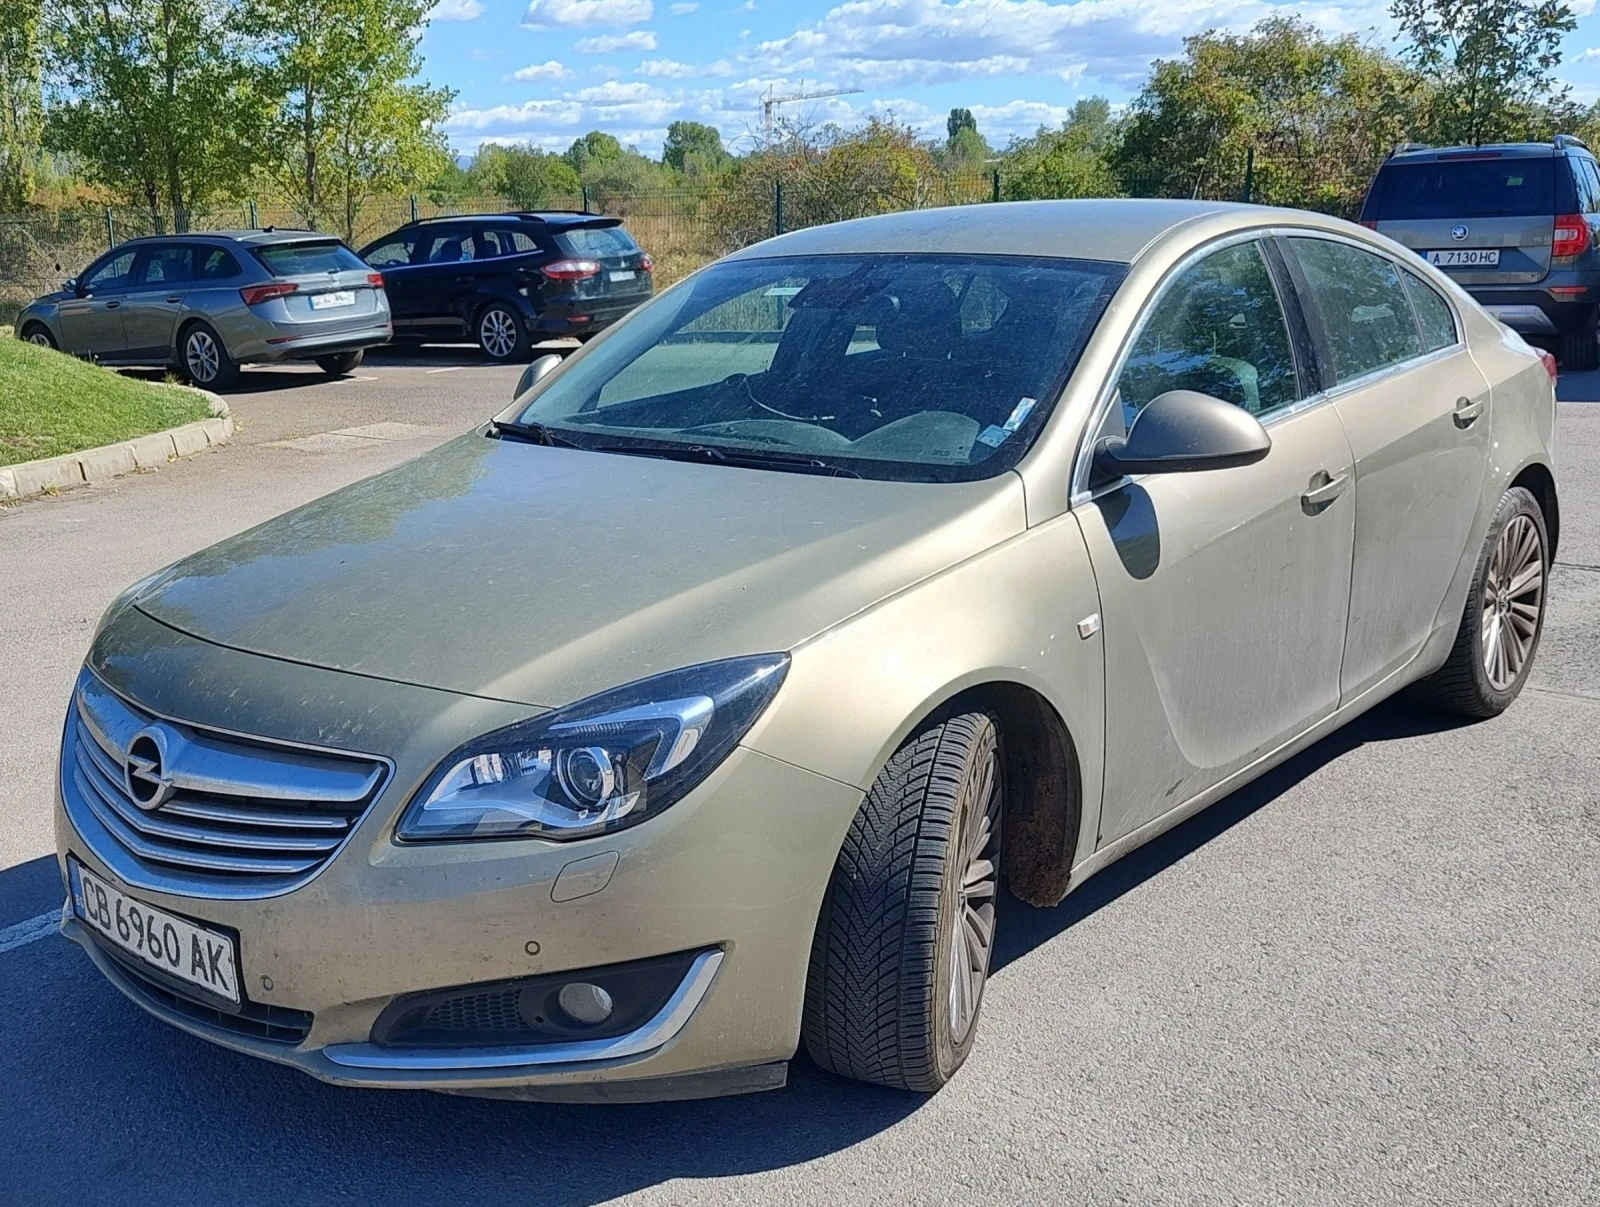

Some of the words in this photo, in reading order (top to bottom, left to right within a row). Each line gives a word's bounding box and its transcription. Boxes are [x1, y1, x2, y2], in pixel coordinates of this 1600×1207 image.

[1432, 253, 1441, 264] A
[1447, 252, 1477, 264] 7130
[1478, 252, 1497, 263] HC
[82, 876, 112, 930] CB
[115, 898, 181, 968] 6960
[190, 933, 231, 992] AK
